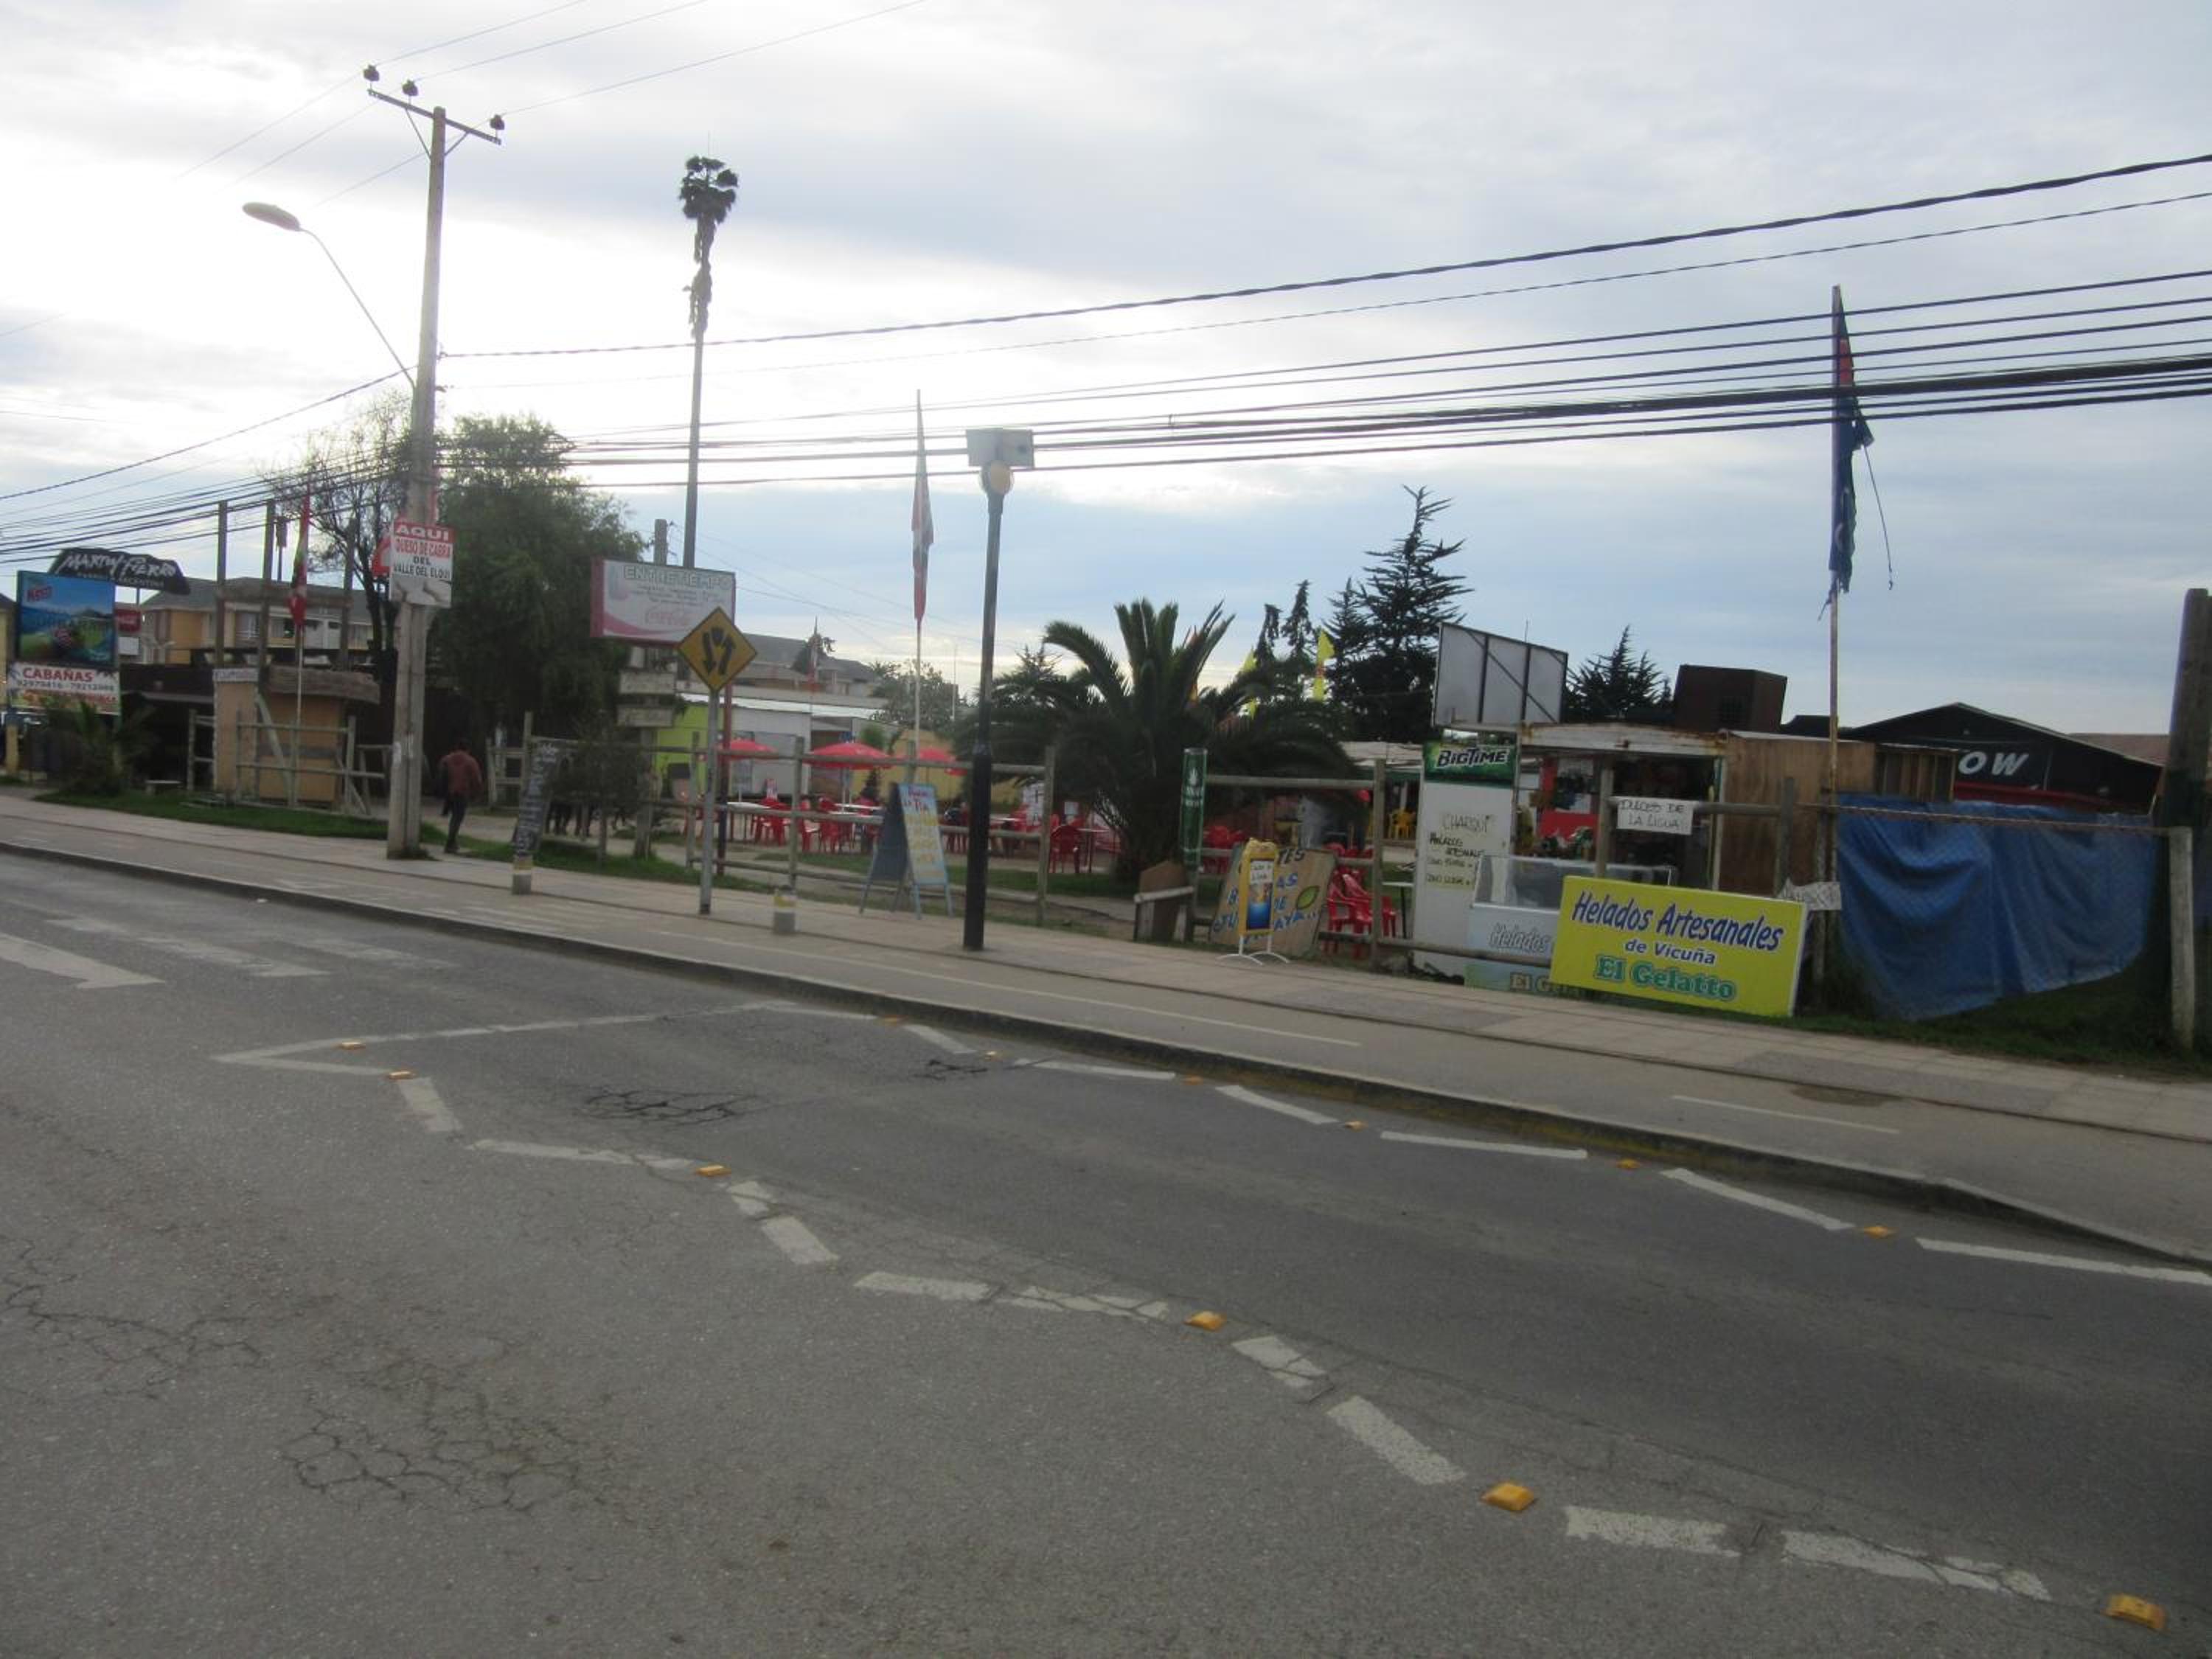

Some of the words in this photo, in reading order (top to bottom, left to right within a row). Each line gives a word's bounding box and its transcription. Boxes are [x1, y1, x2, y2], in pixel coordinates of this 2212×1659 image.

[413, 555, 431, 566] DEL
[415, 566, 428, 577] DEL
[1571, 890, 1655, 932] Helados
[1655, 902, 1784, 953] Artesanales
[1488, 922, 1551, 953] Helados
[1624, 938, 1647, 954] de
[1654, 942, 1717, 965] Vicuña
[1594, 955, 1629, 983] El
[1630, 959, 1737, 1001] Gelatto
